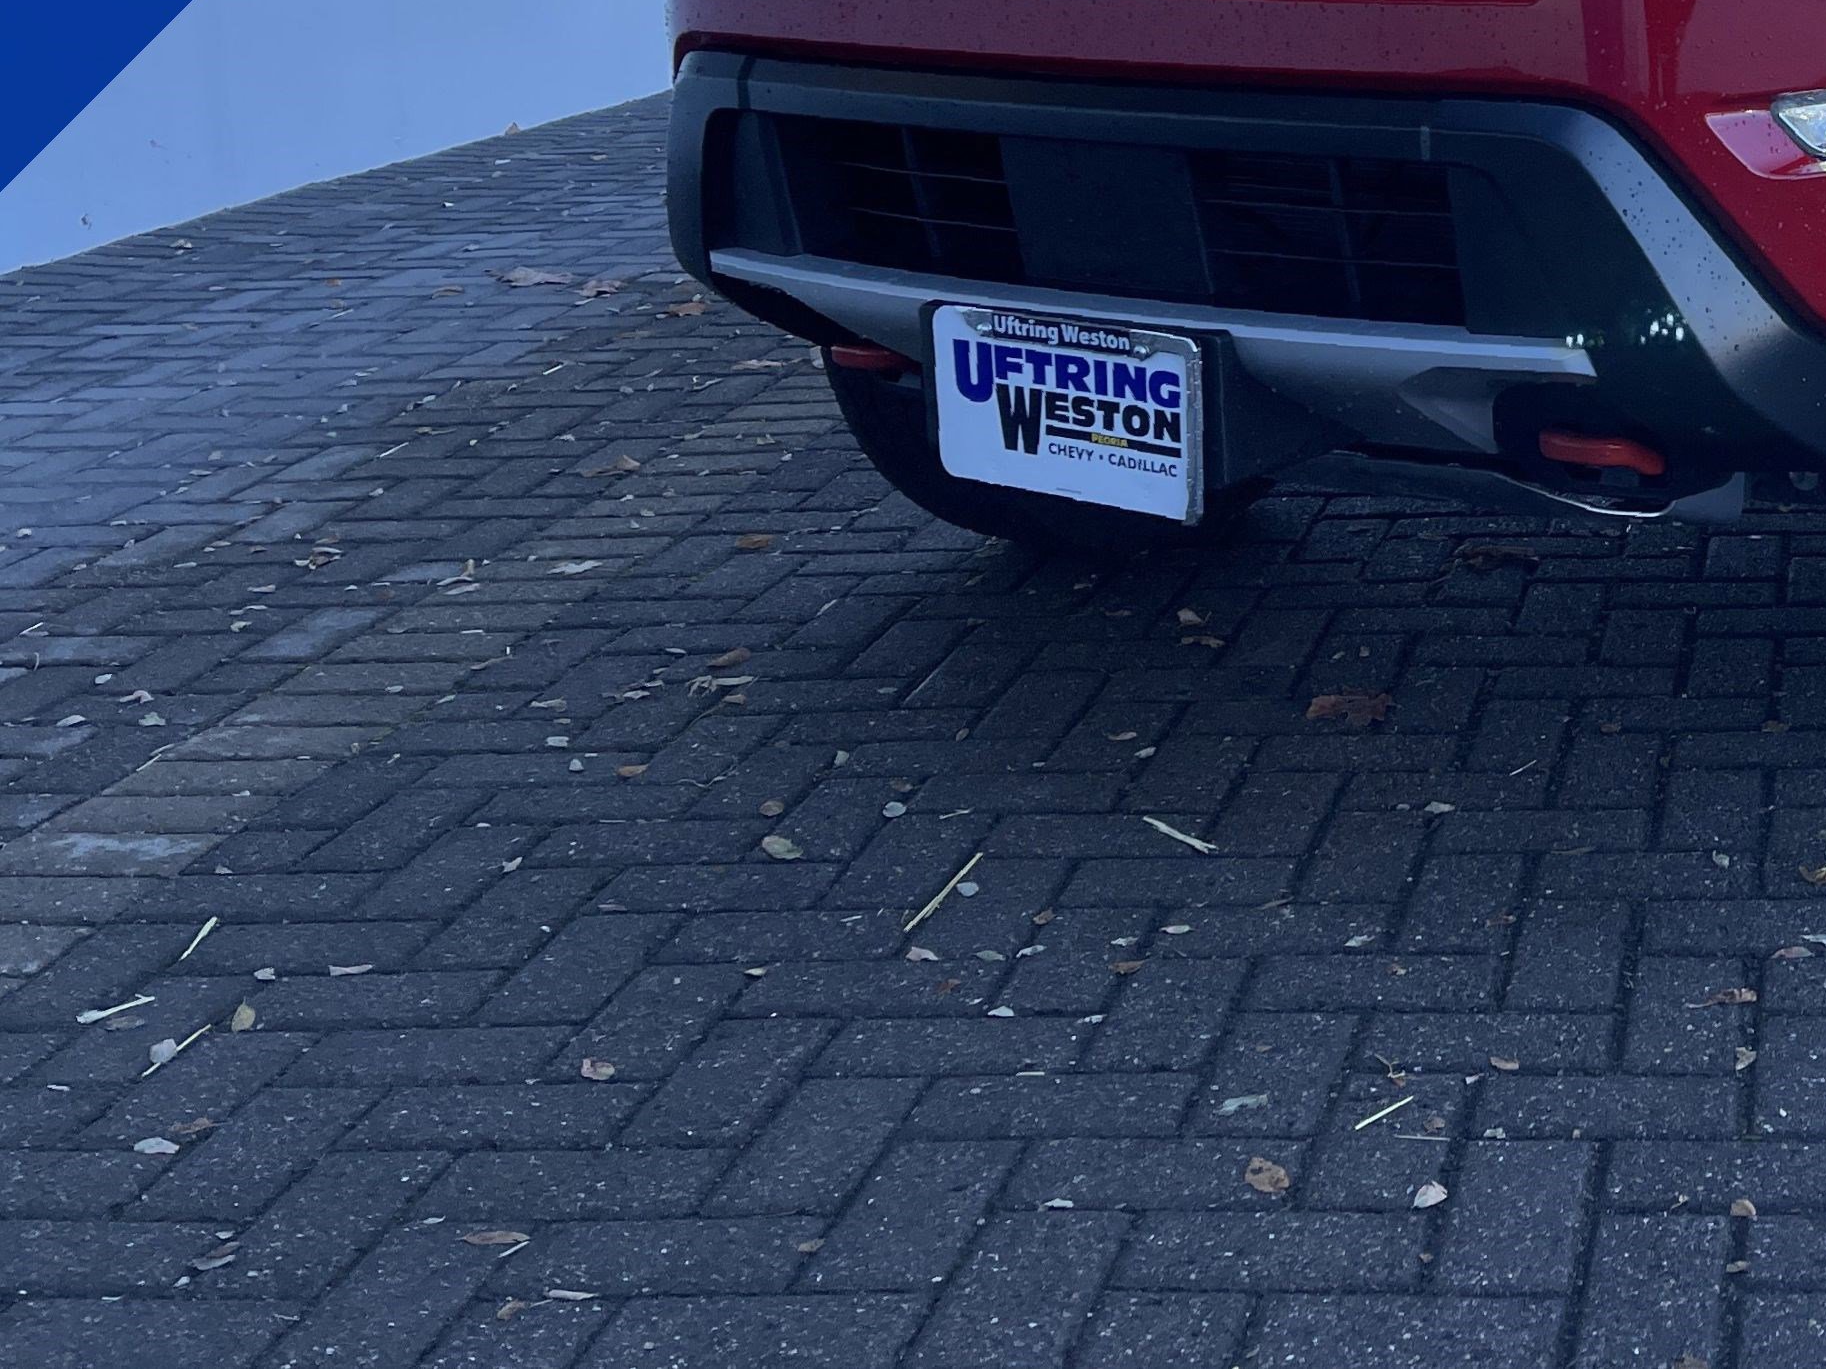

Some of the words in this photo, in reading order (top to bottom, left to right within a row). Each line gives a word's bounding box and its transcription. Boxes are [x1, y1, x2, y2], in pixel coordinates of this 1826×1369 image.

[993, 315, 1059, 345] Uftring
[1060, 324, 1131, 350] Weston
[952, 338, 1182, 408] UFTRING
[995, 383, 1182, 455] WESTON
[1091, 433, 1129, 448] PEORIA
[1047, 442, 1095, 462] CHEVY
[1107, 453, 1178, 478] CADILLAC
